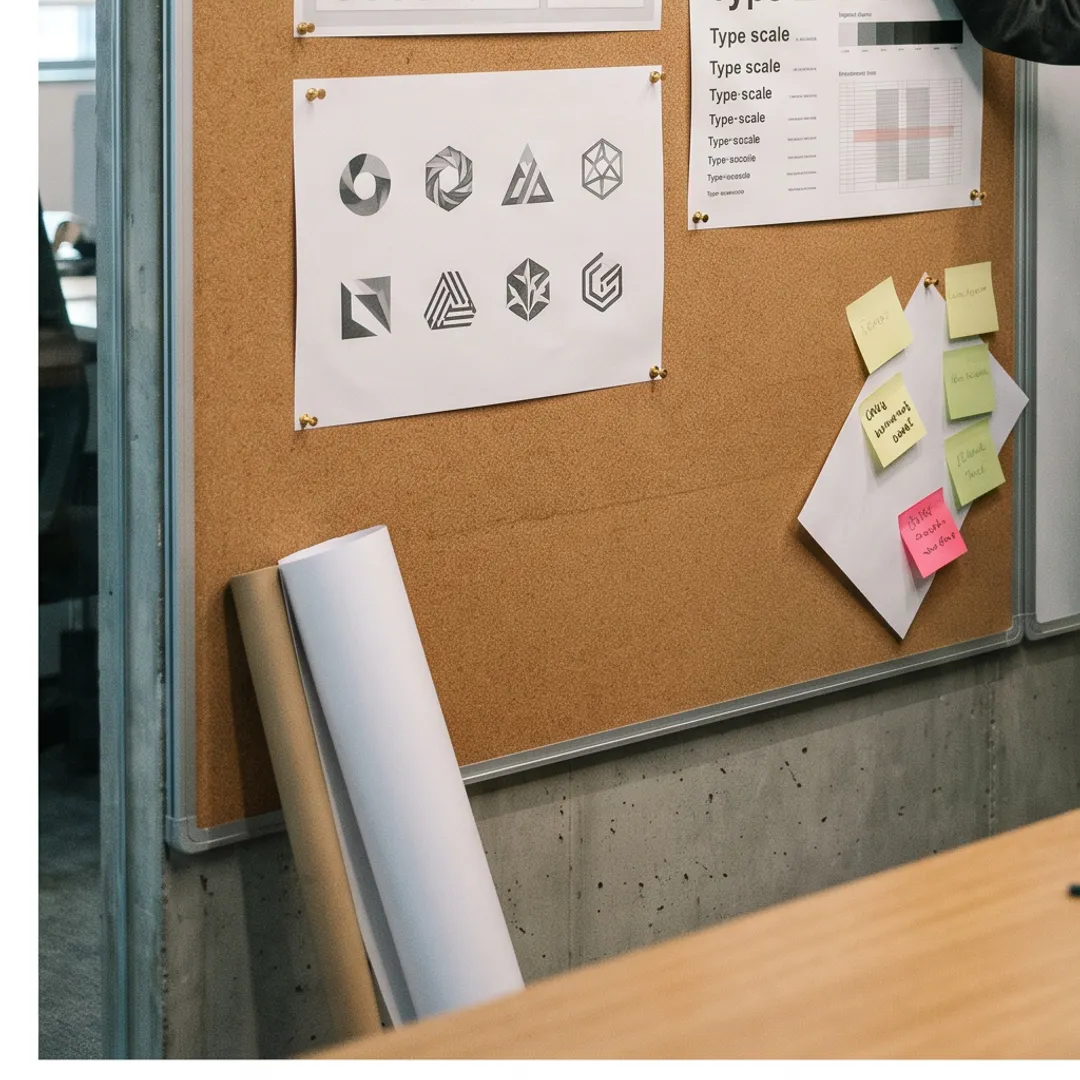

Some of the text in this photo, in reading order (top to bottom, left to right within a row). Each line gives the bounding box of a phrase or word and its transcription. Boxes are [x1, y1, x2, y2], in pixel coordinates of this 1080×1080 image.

[709, 25, 790, 48] Type scale
[709, 58, 781, 79] Type scale
